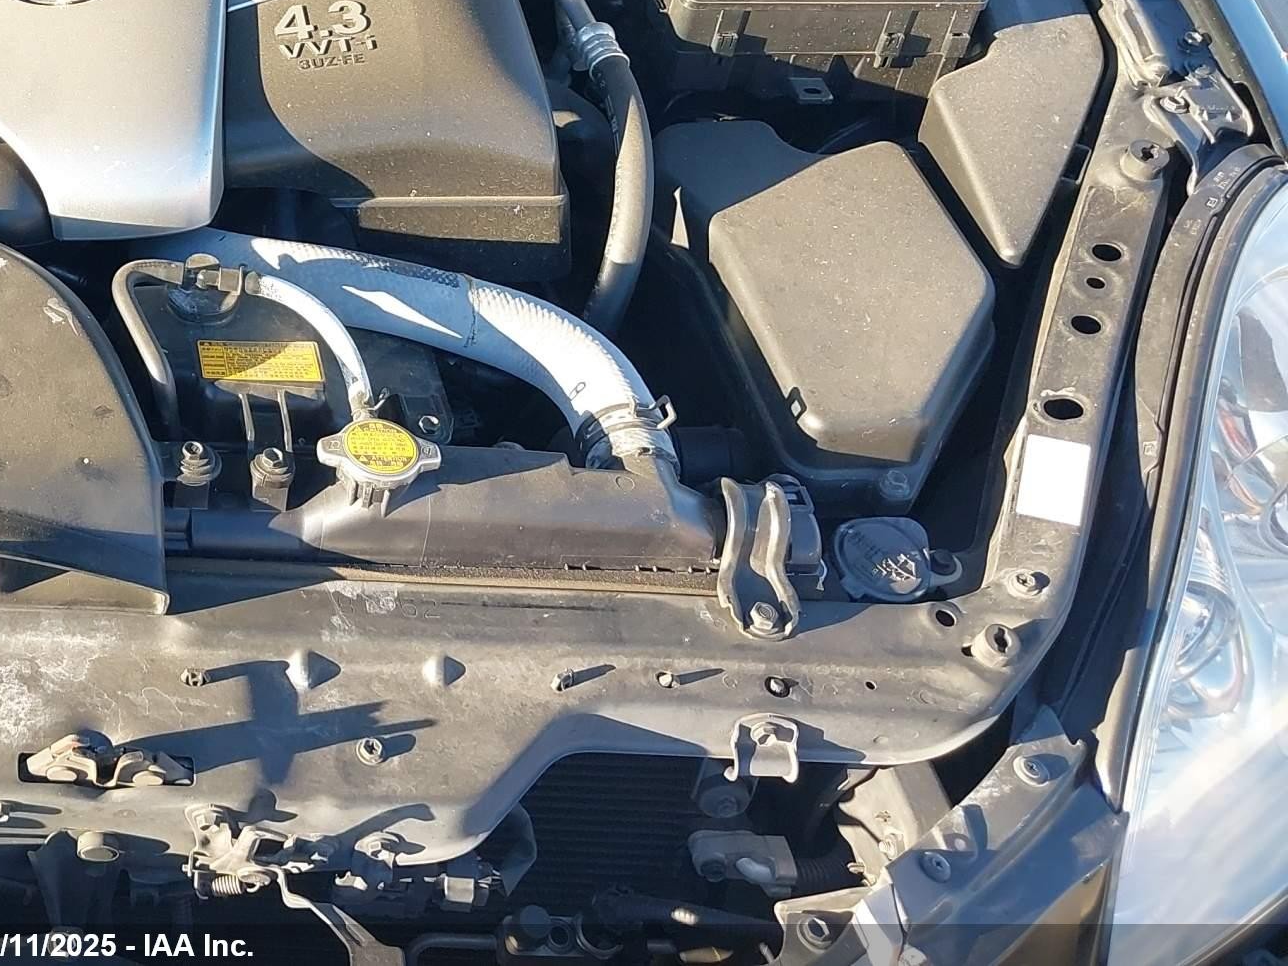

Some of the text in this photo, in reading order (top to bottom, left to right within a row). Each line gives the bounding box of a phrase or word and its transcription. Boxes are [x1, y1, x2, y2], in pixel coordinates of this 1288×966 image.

[274, 0, 371, 40] 4.3
[279, 35, 378, 60] VVT-i
[298, 53, 366, 70] 3UZ-FE
